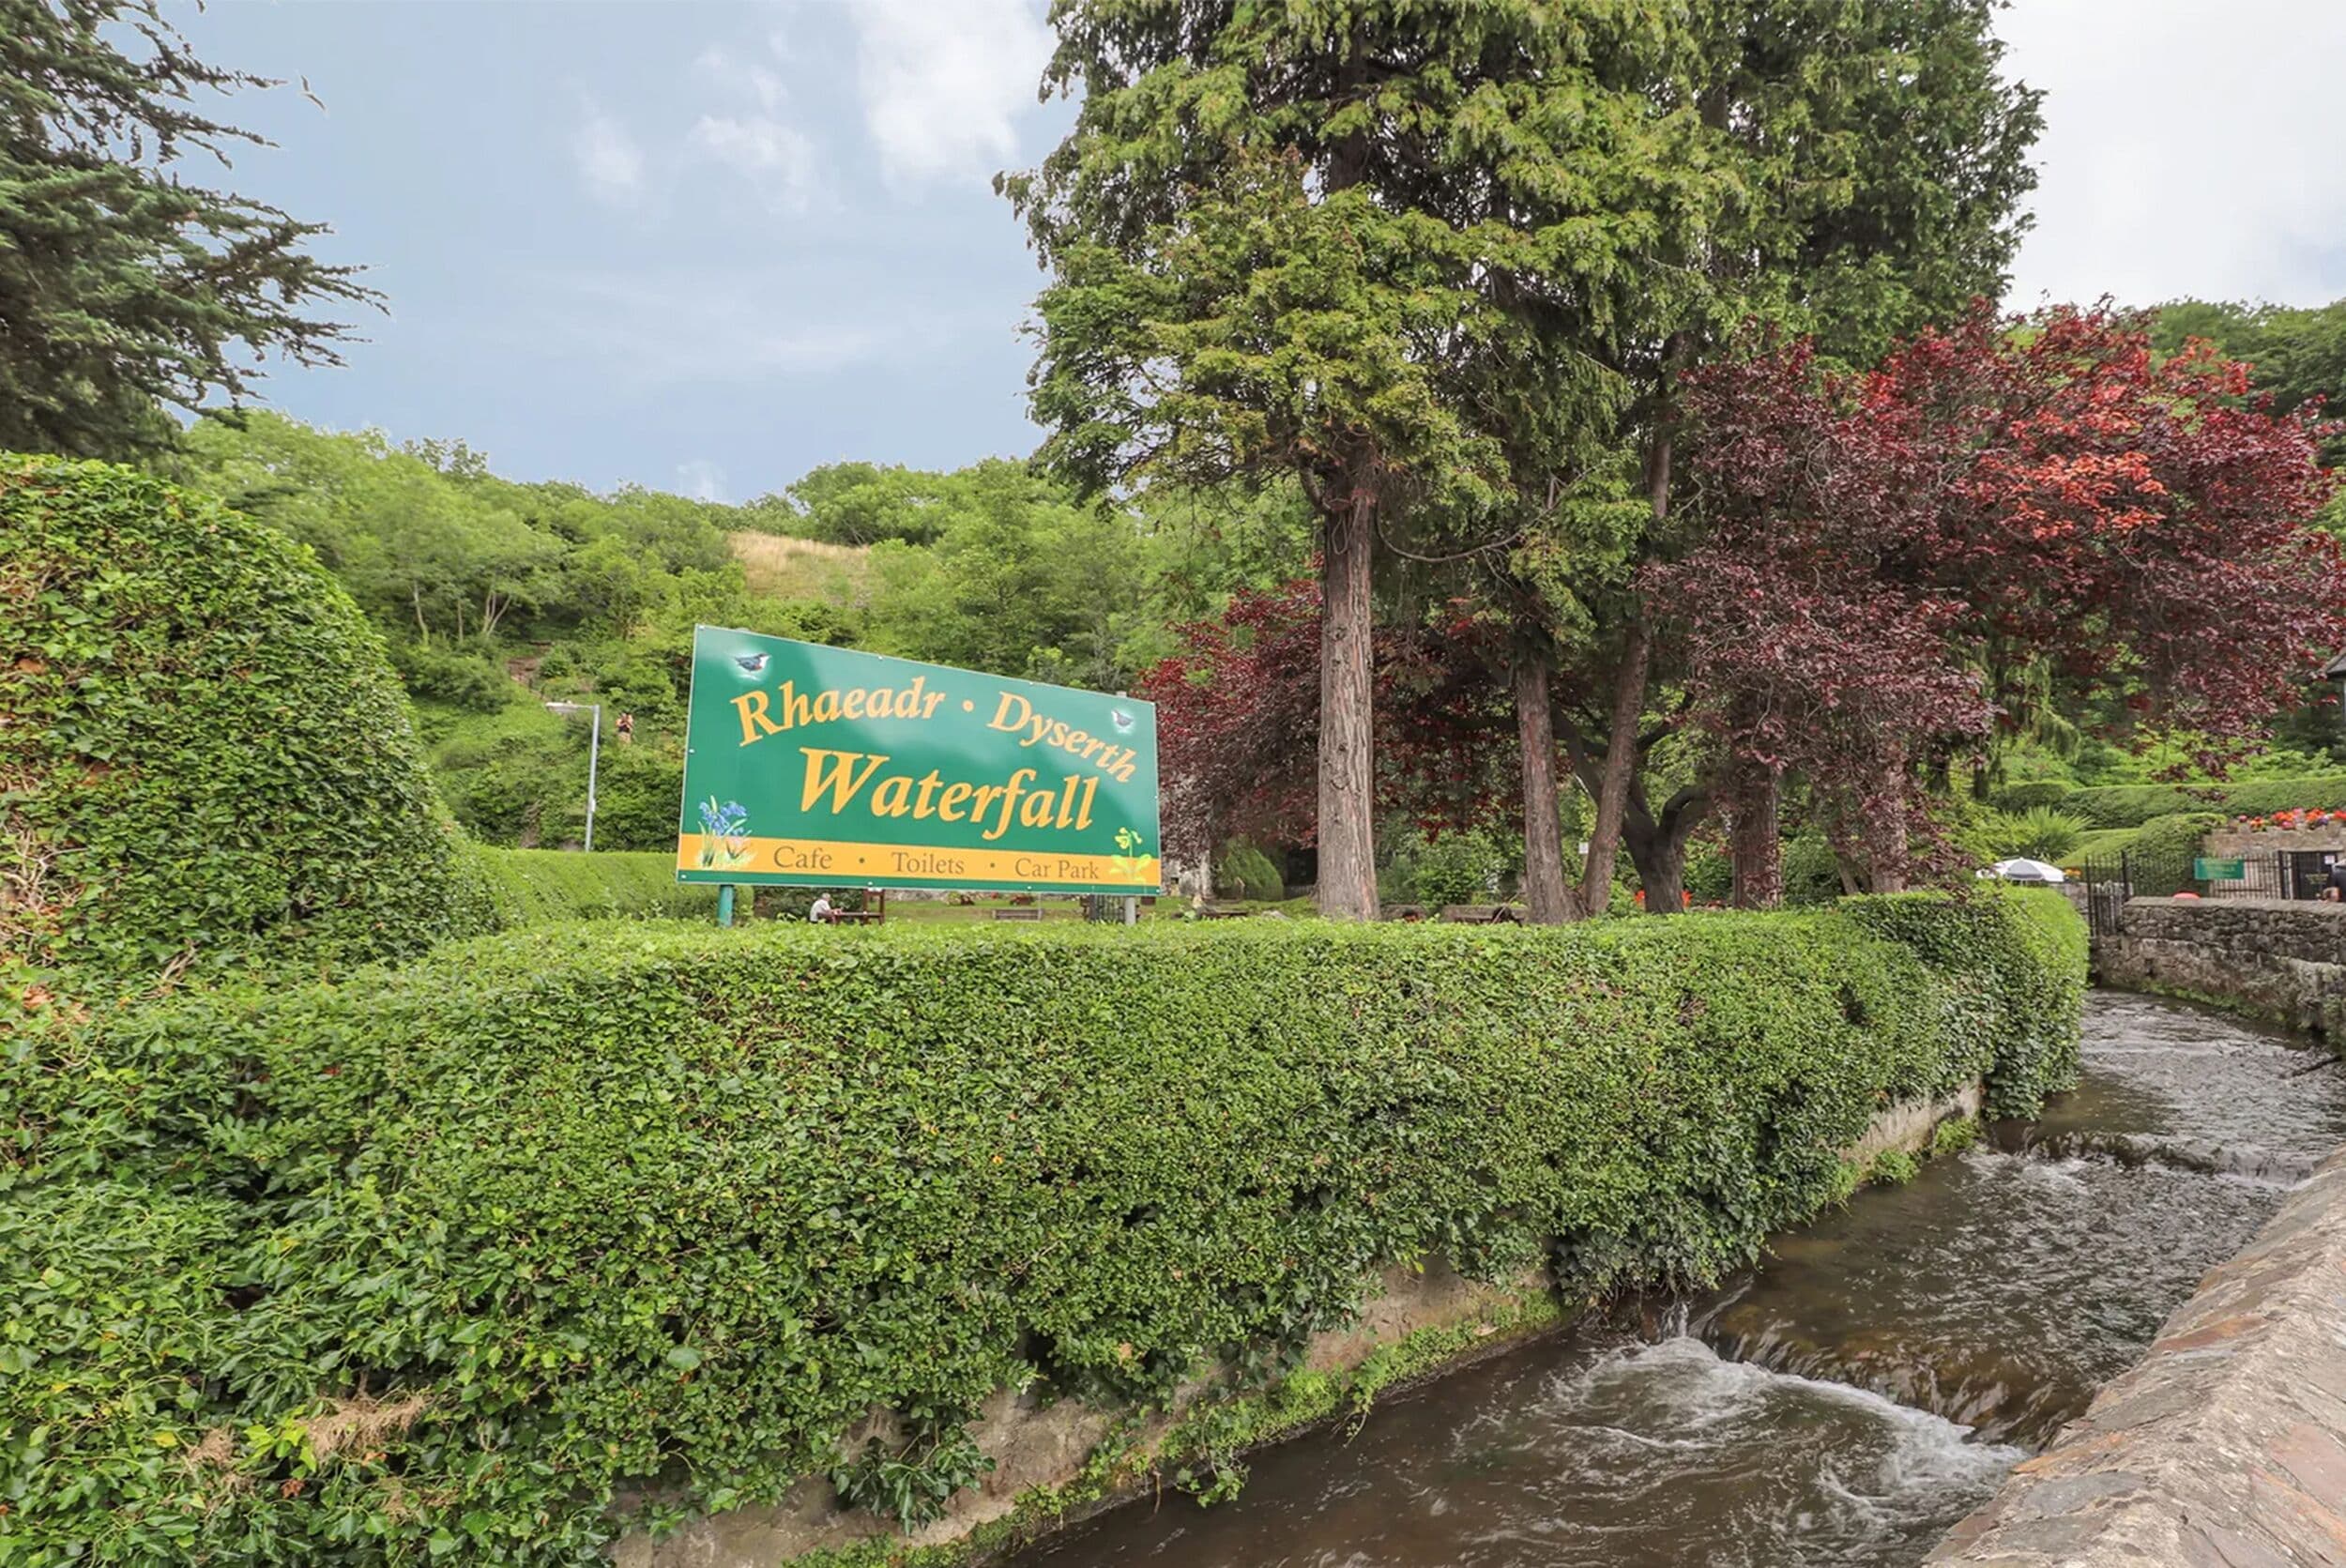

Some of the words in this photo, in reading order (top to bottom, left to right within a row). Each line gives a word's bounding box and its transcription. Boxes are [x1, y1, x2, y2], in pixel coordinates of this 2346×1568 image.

[729, 675, 947, 747] Rhaeadr
[986, 691, 1137, 783] Dyserth
[799, 746, 1100, 841] Waterfall
[772, 845, 833, 870] Cafe
[891, 851, 966, 875] Toilets
[1014, 857, 1051, 877] Car
[1057, 860, 1100, 879] Park
